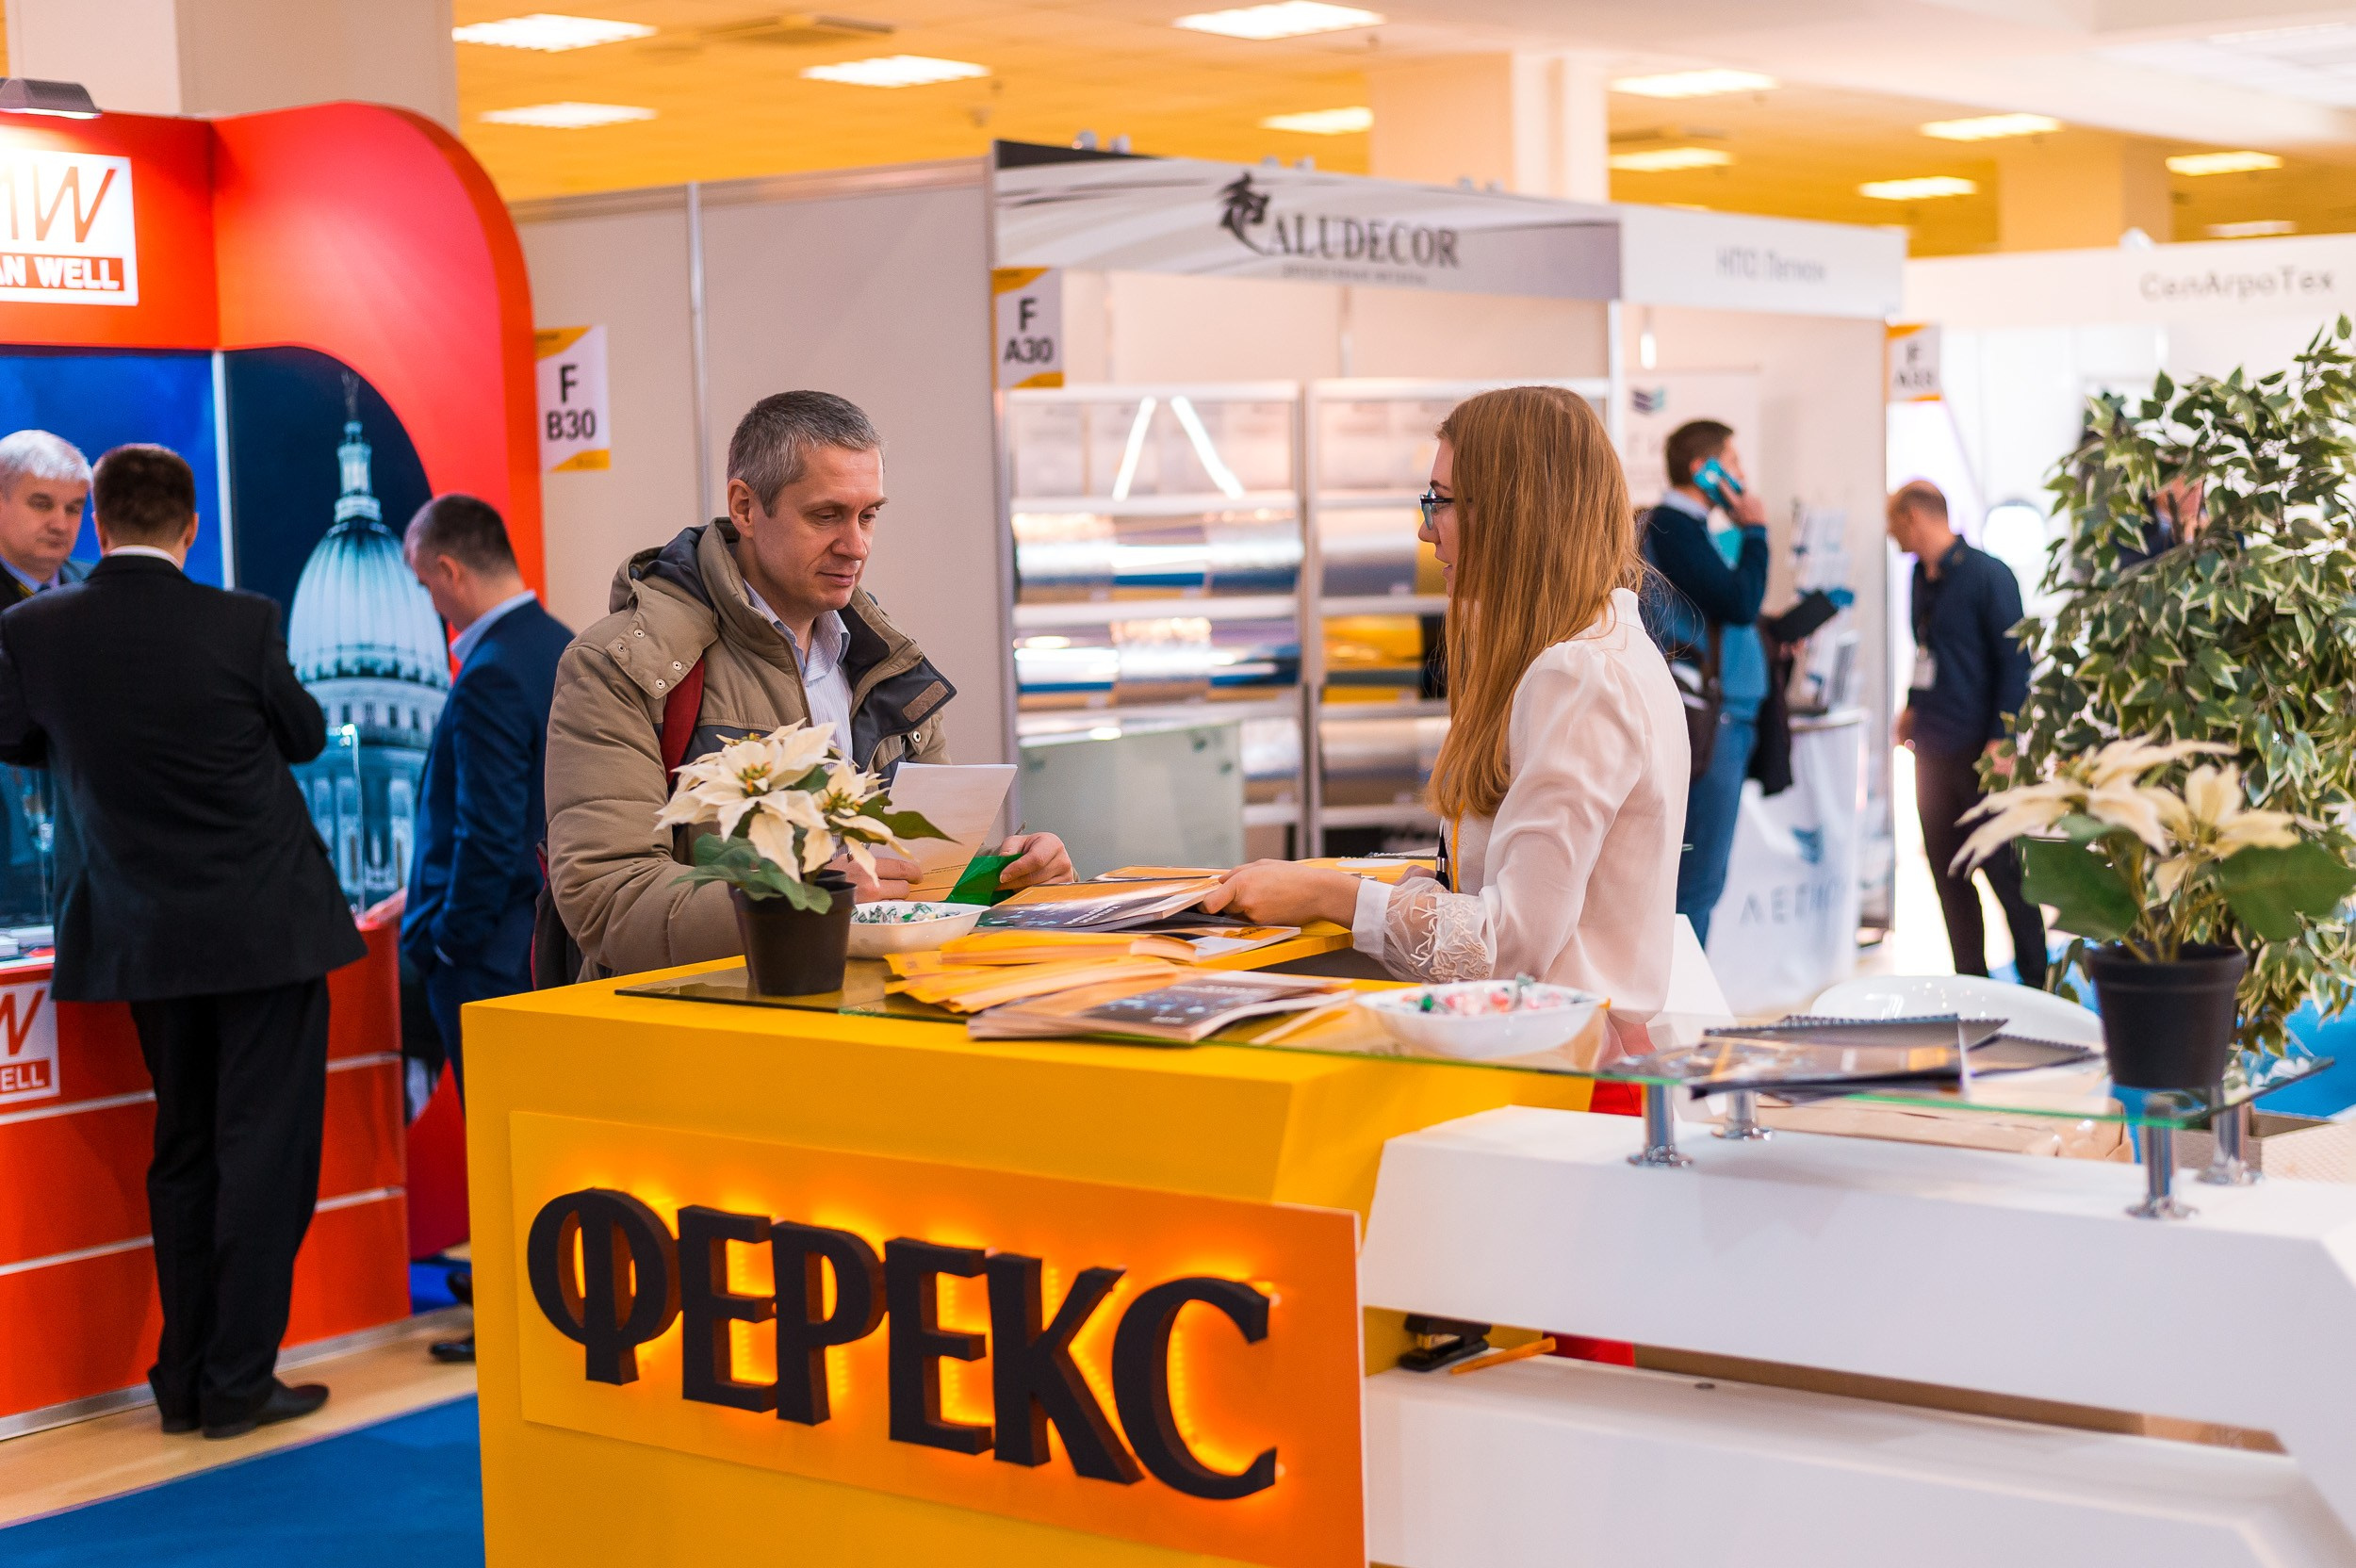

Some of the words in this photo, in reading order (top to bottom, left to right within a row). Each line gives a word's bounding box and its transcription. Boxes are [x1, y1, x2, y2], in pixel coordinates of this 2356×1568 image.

[1268, 213, 1461, 270] ALUDECOR
[33, 256, 120, 290] WELL
[1019, 297, 1038, 332] F
[1004, 337, 1055, 364] A30
[560, 364, 578, 403] F
[546, 409, 597, 441] B30
[1, 1063, 46, 1093] ELL
[527, 1187, 1278, 1500] ФЕРЕКС
